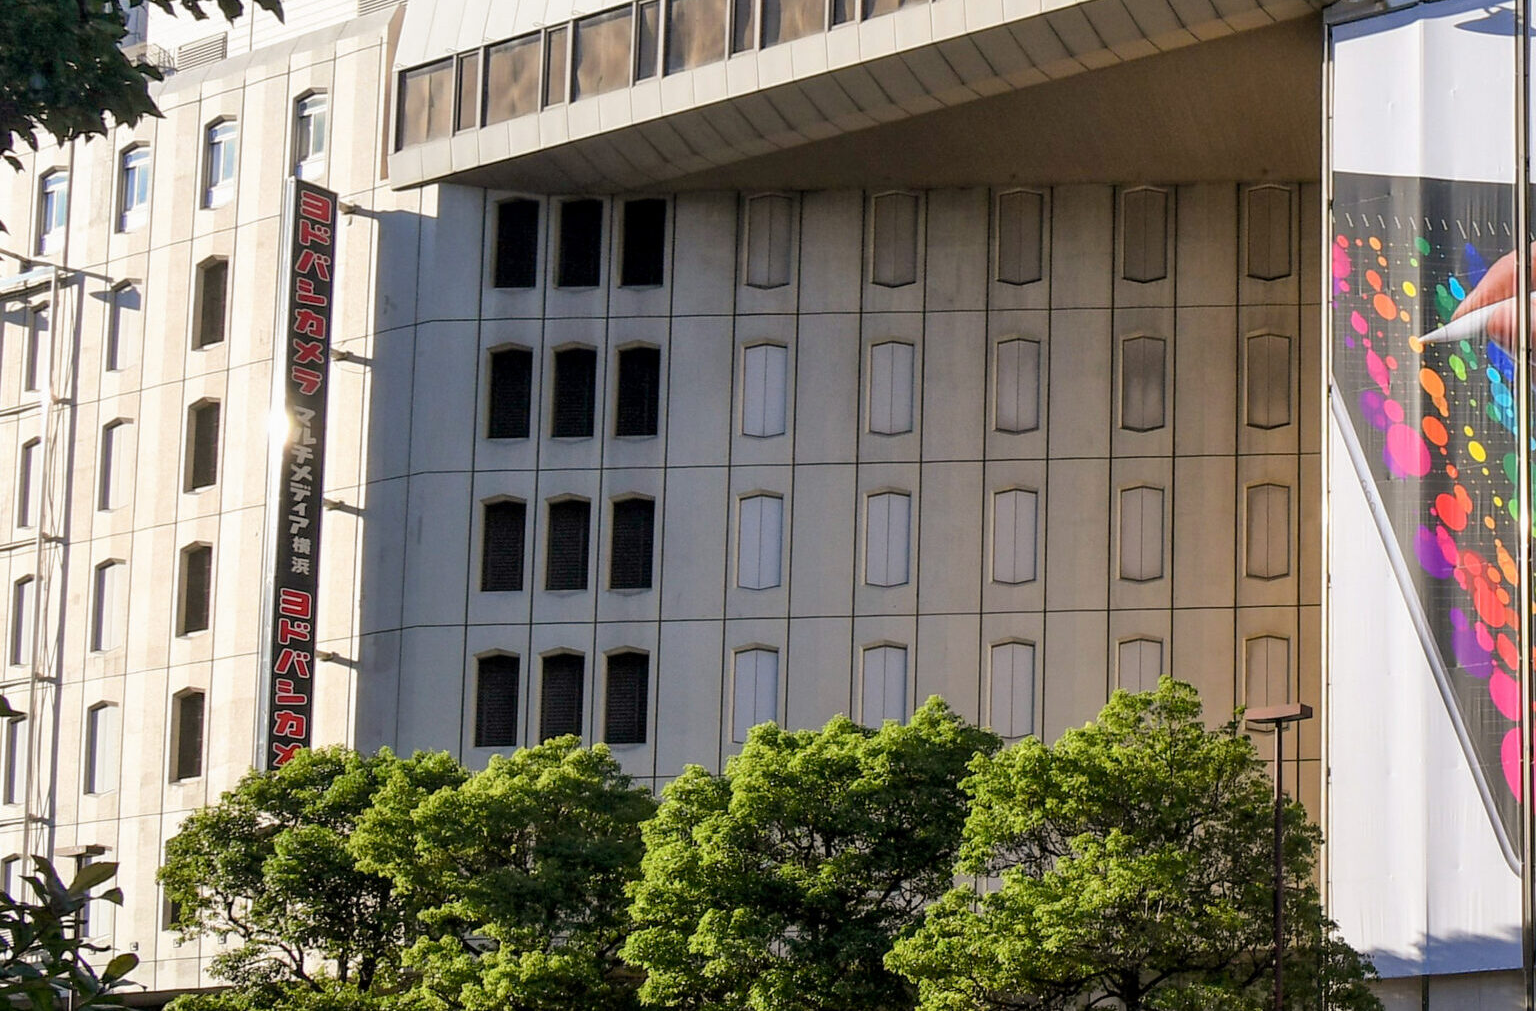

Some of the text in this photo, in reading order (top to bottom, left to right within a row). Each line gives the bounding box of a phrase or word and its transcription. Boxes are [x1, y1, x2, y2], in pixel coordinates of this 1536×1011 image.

[291, 191, 332, 395] ヨドバシカメラ
